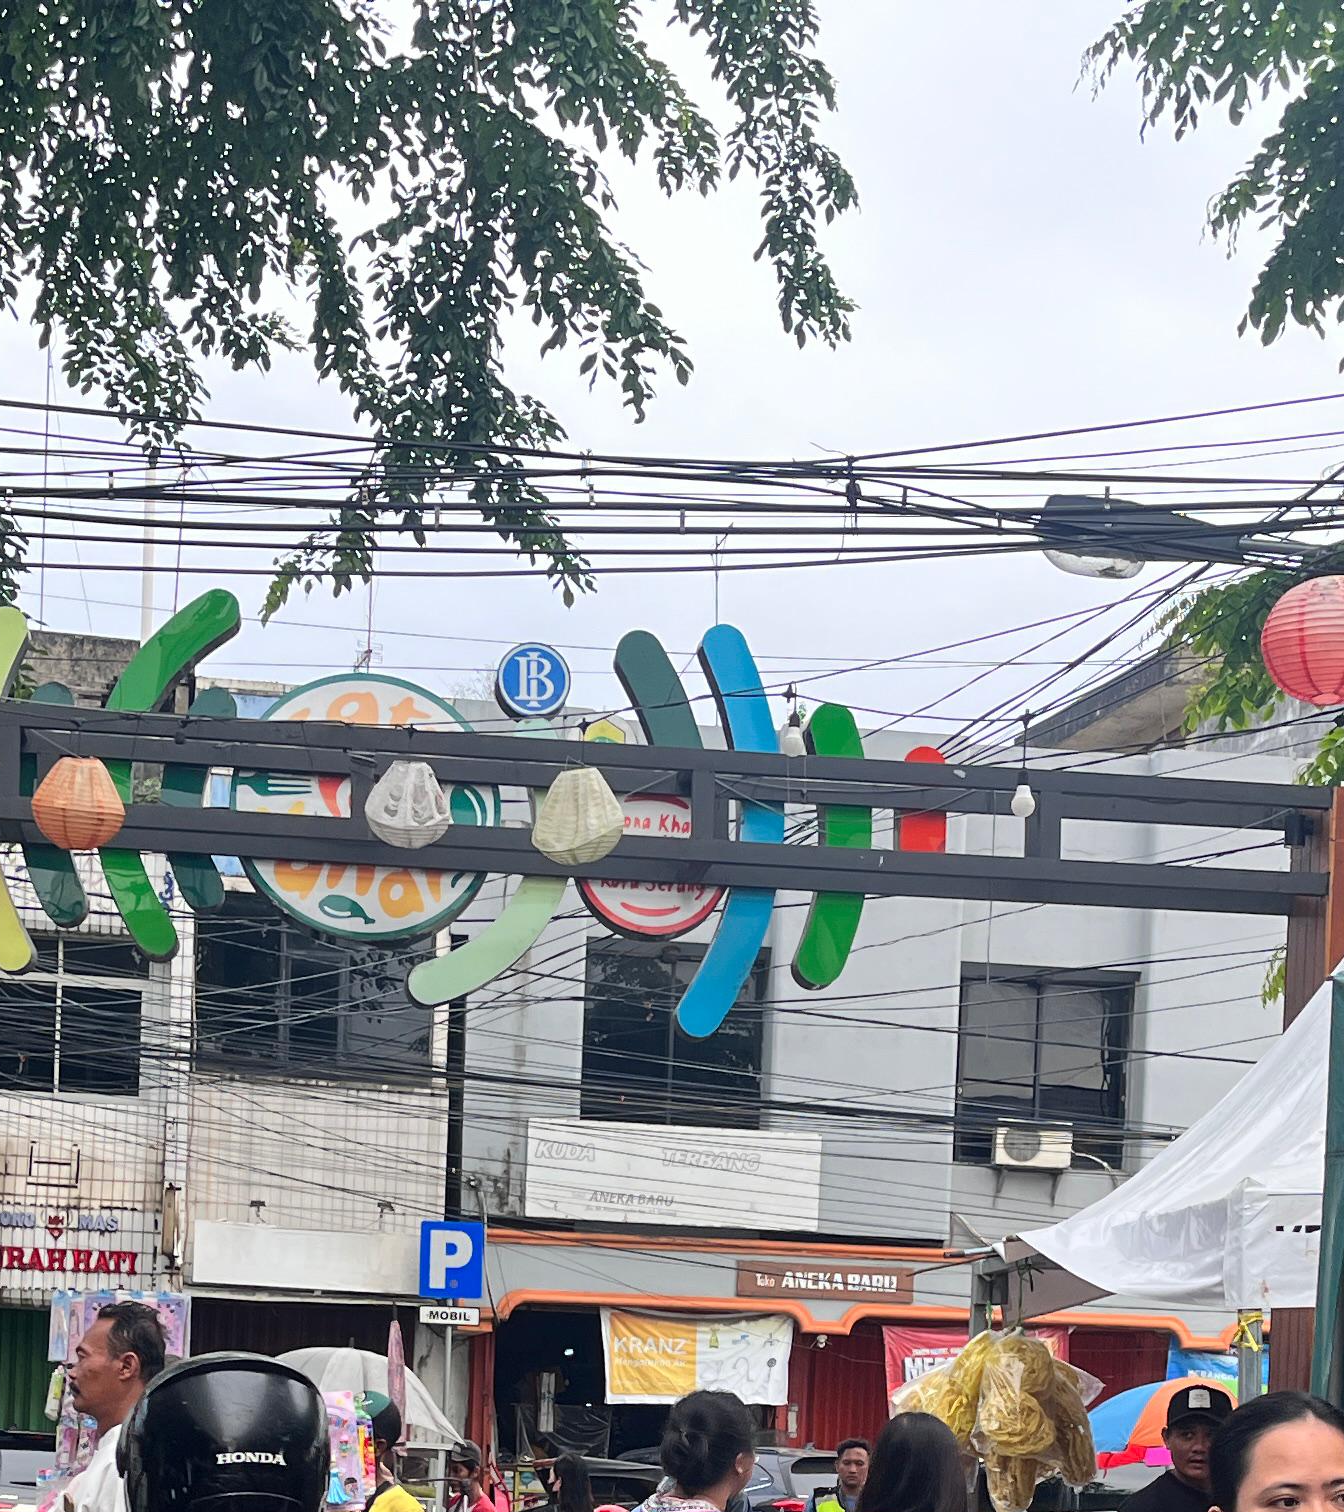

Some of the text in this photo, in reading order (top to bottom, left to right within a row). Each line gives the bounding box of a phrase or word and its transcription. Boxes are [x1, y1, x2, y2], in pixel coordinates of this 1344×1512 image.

[535, 1140, 762, 1172] KUDA TERBANG
[589, 1190, 634, 1206] ANEKA
[637, 1194, 675, 1208] BARU
[78, 1214, 119, 1232] MAS
[72, 1247, 138, 1276] HATI
[429, 1229, 474, 1290] P
[756, 1271, 898, 1293] Toko ANEKA BARU
[429, 1309, 471, 1322] MOBIL
[613, 1335, 690, 1356] KRANZ
[215, 1451, 288, 1467] HONDA
